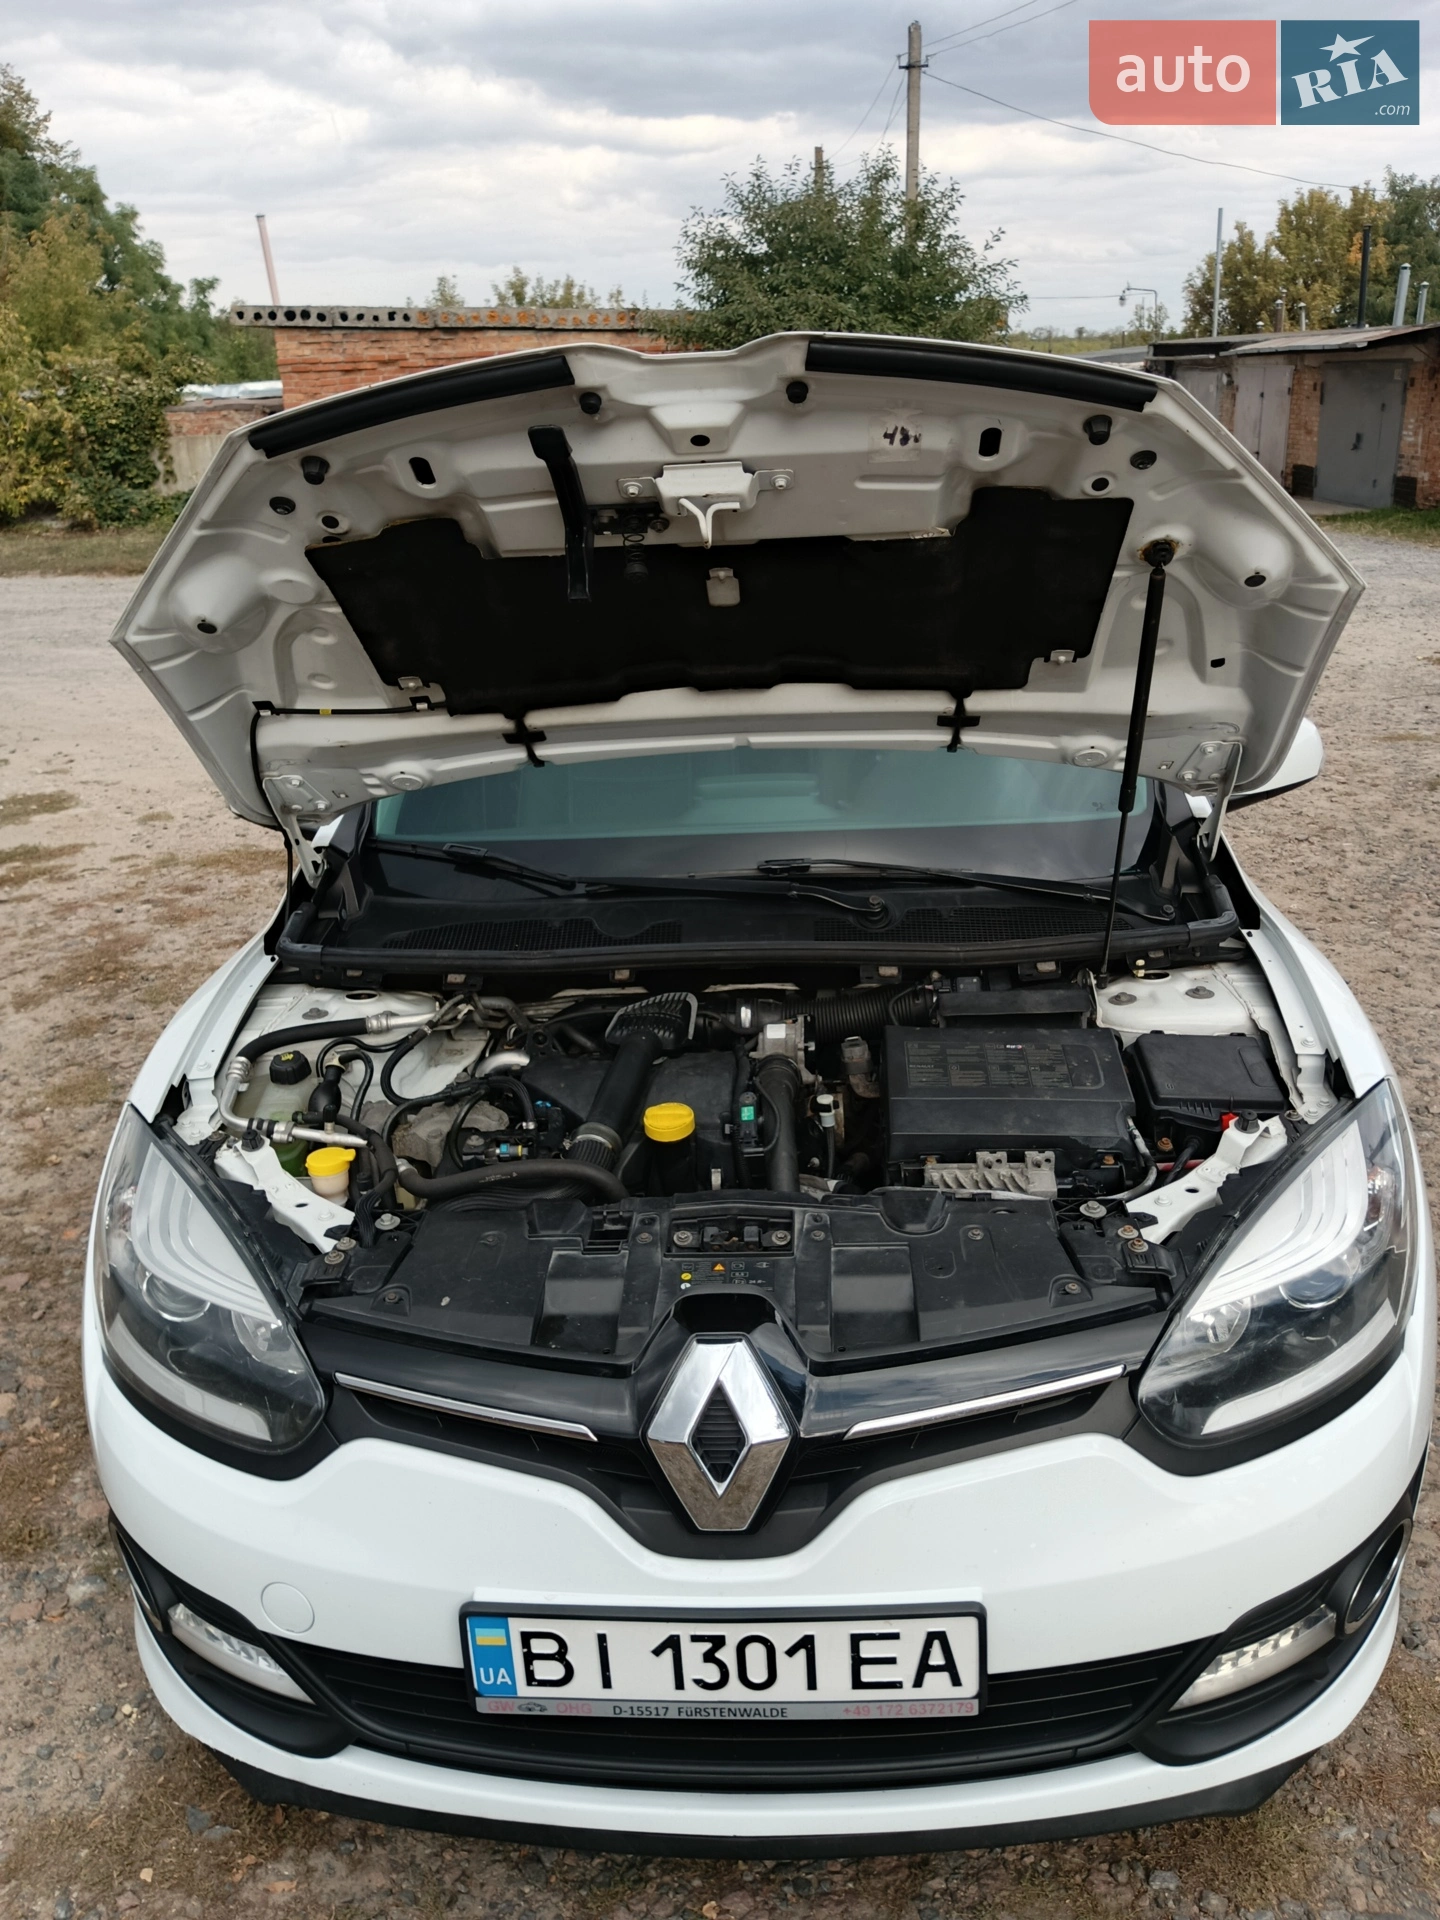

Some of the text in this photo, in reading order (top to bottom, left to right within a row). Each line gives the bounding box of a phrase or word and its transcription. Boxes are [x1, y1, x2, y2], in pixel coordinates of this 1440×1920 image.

[519, 1630, 963, 1691] BI 1301 EA
[479, 1667, 512, 1686] UA
[487, 1701, 515, 1712] GW
[556, 1702, 593, 1715] OHG
[613, 1705, 669, 1718] D-15517
[842, 1704, 871, 1717] +49
[876, 1703, 903, 1716] 172
[908, 1702, 974, 1715] 6372179
